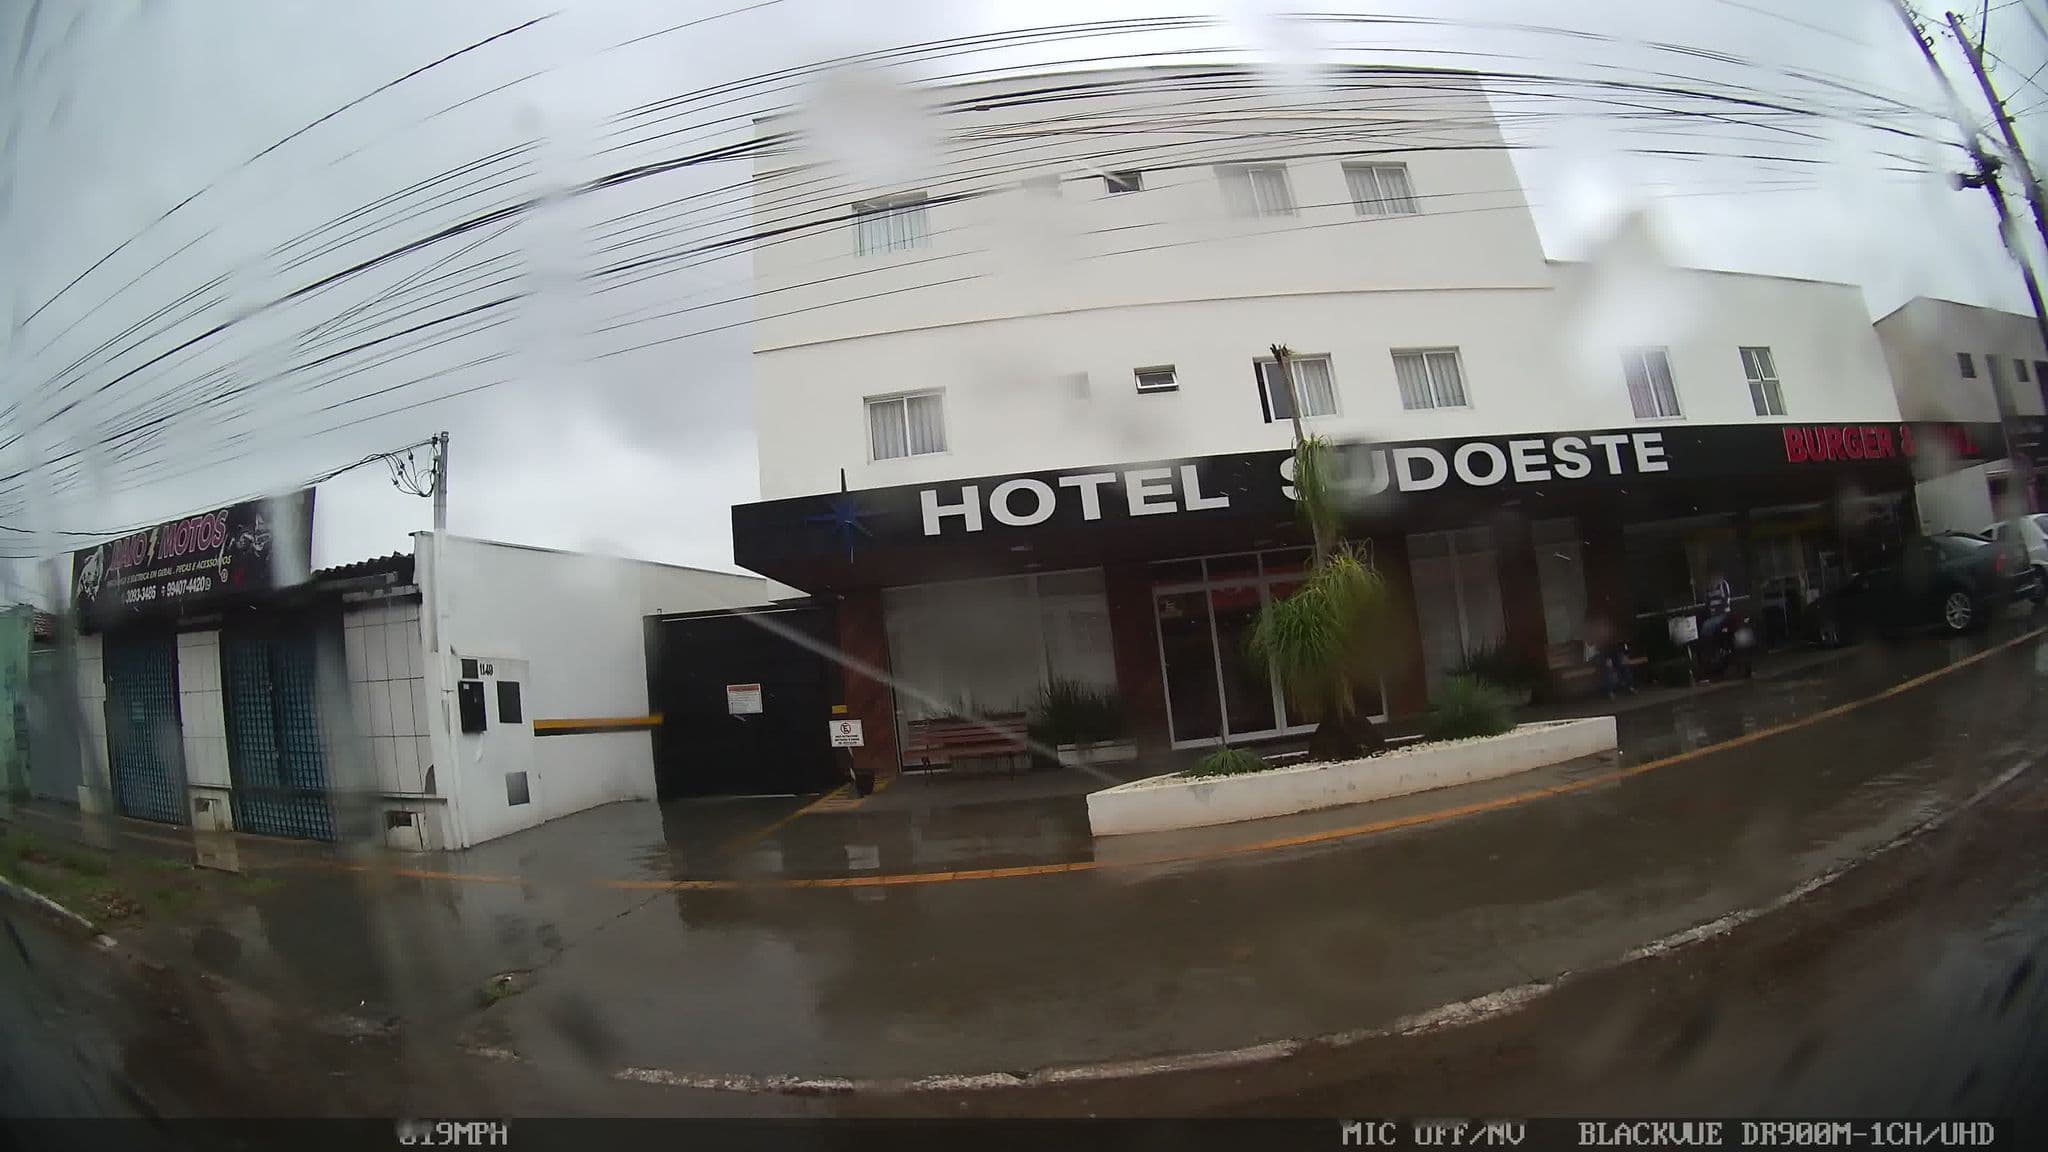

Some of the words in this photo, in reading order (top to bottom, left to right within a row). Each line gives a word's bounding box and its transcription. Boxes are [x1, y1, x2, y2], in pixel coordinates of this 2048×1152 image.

[1783, 425, 1895, 462] BURGER
[920, 464, 1230, 536] HOTEL
[158, 509, 229, 560] MOTOS
